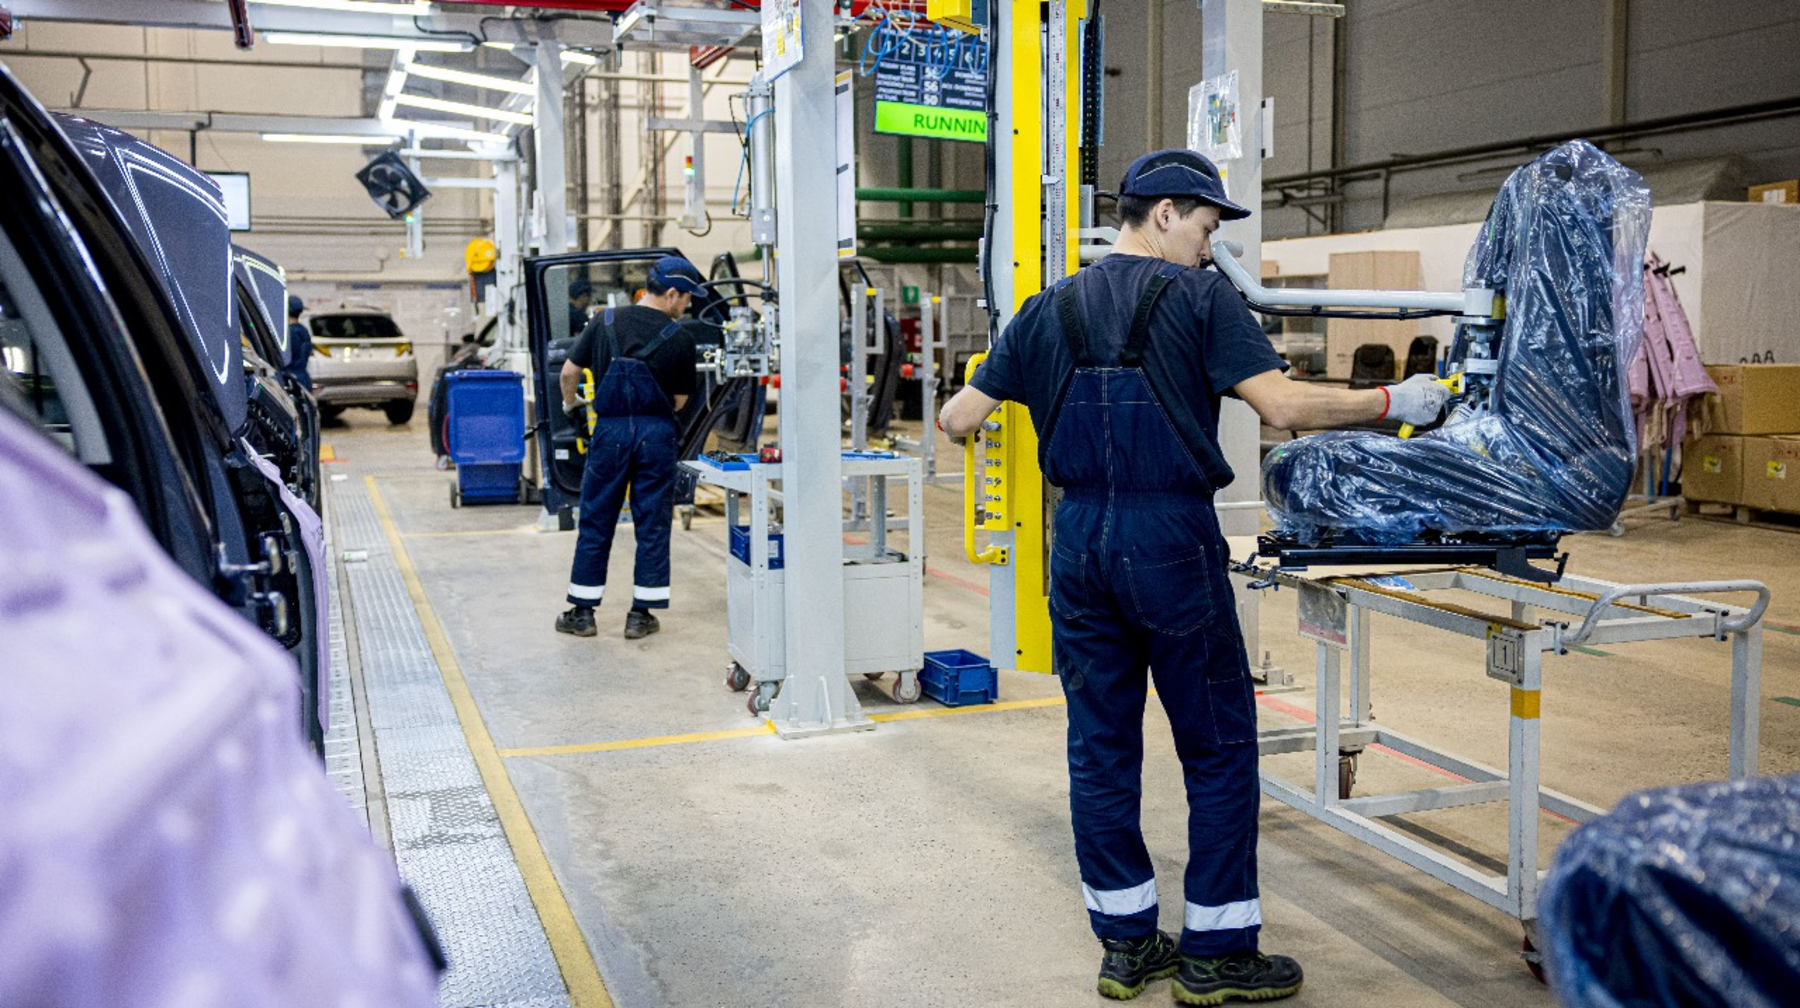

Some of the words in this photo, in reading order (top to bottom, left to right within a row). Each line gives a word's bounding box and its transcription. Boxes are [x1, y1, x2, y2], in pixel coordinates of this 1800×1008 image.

[901, 42, 910, 55] 2
[918, 44, 926, 57] 3
[923, 80, 939, 92] 56
[923, 93, 939, 106] 50
[914, 113, 986, 134] RUNNIN
